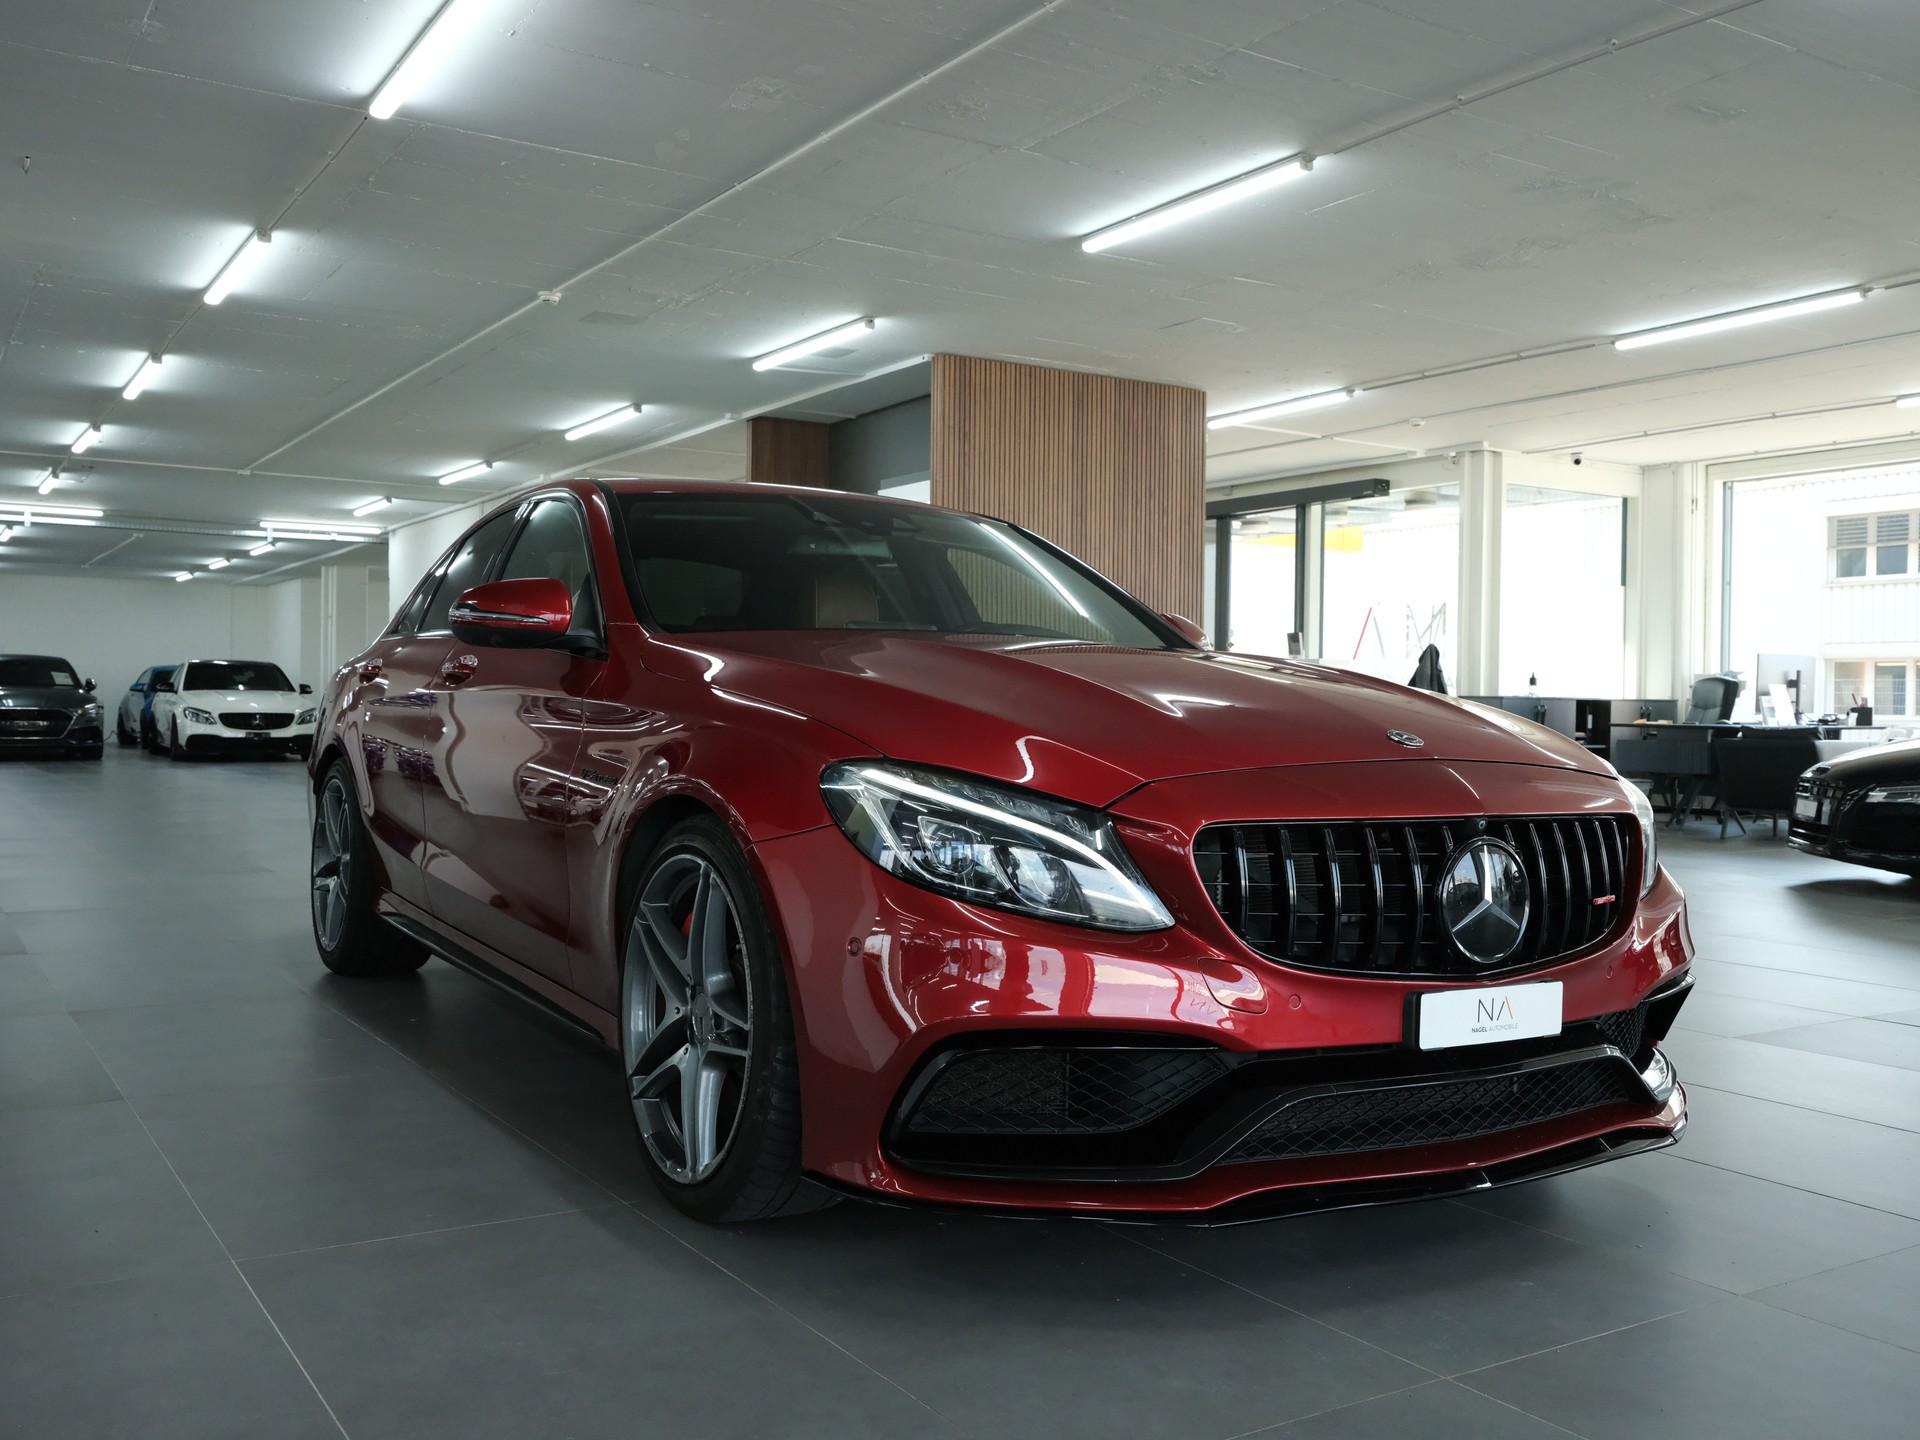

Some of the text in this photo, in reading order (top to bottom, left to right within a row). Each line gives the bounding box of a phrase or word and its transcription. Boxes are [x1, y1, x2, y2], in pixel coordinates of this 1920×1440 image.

[1477, 996, 1514, 1023] NA
[1471, 1022, 1518, 1034] NAGEL AUTOMOBILE
